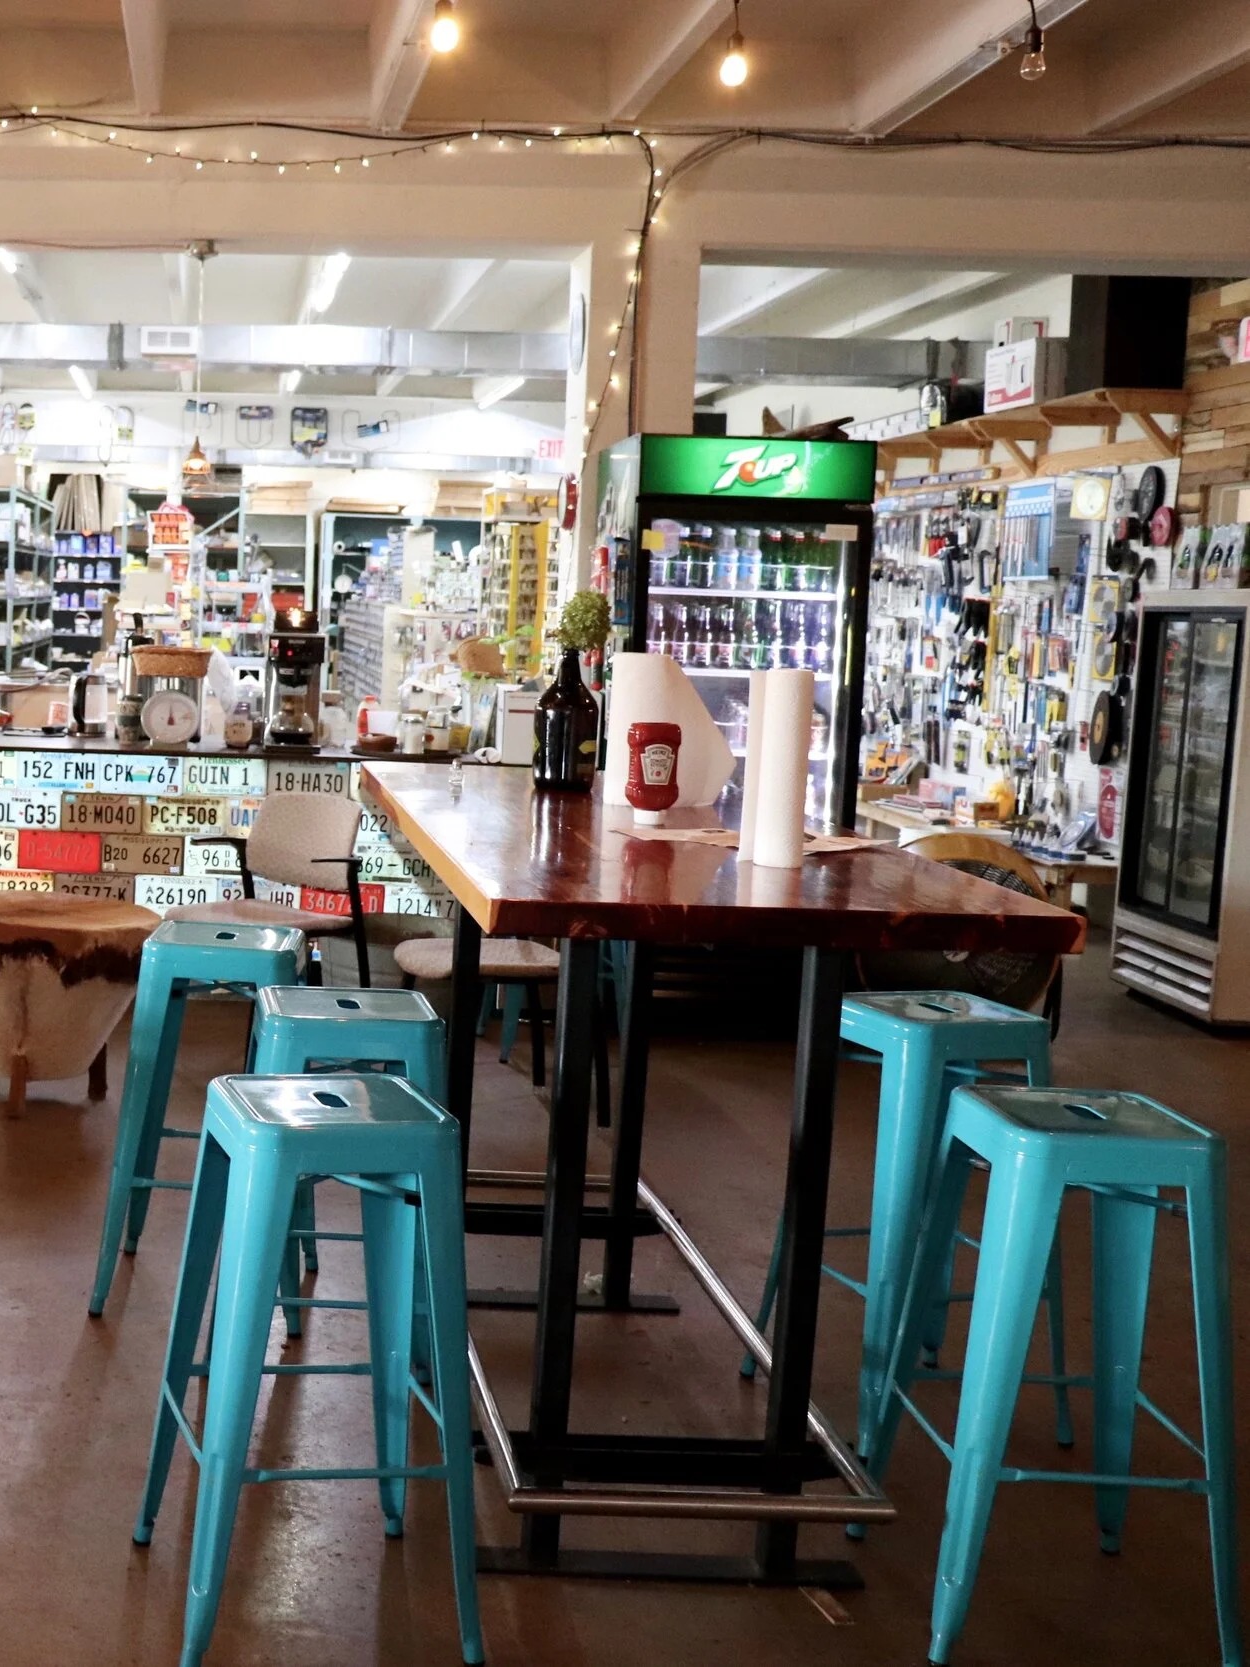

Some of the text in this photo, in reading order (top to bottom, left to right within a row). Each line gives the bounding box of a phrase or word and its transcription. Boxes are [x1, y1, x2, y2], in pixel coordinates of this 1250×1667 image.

[23, 760, 95, 780] 152 FNH
[104, 763, 134, 783] CPK
[188, 765, 230, 785] GUIN
[142, 847, 180, 865] 6627
[202, 849, 219, 867] 96
[156, 886, 206, 906] 26190
